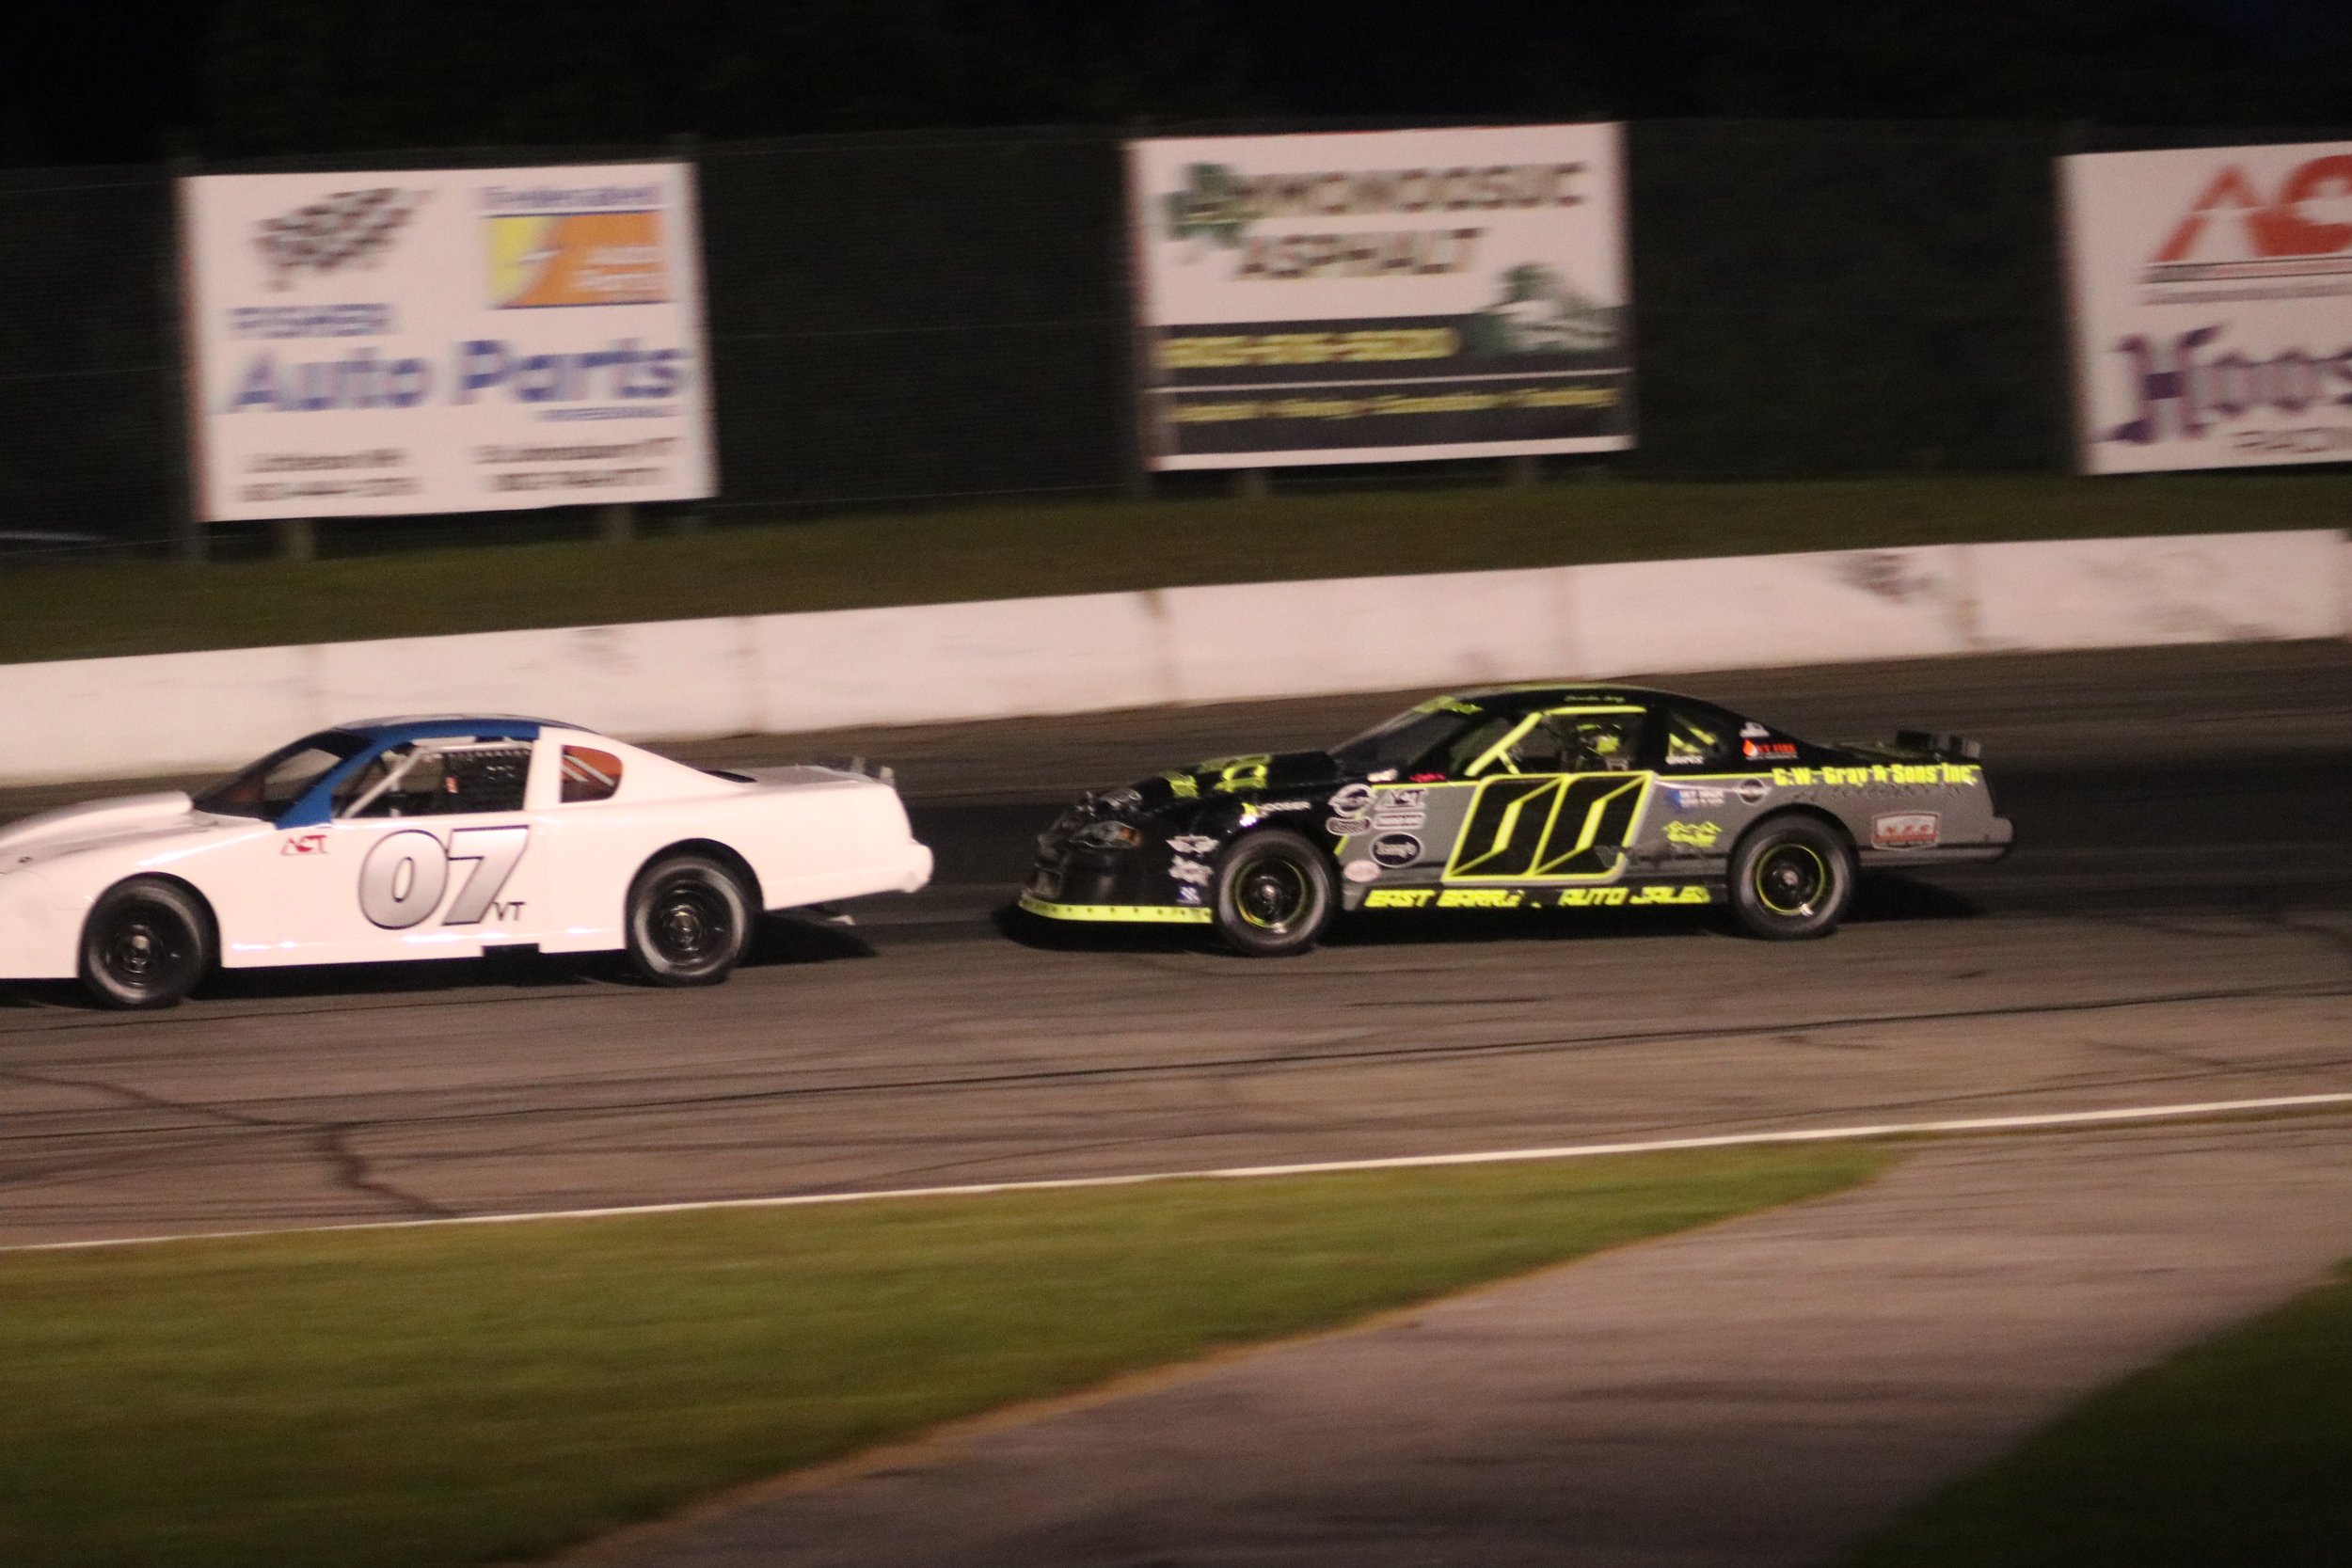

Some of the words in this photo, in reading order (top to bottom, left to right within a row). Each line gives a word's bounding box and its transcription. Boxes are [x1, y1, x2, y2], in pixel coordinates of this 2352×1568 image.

[228, 344, 431, 414] Auto
[457, 335, 692, 406] Parts
[280, 834, 329, 856] ACT
[358, 824, 530, 929] 07
[1364, 889, 1436, 908] EAST
[1558, 886, 1629, 906] AUTO
[490, 901, 527, 921] VT
